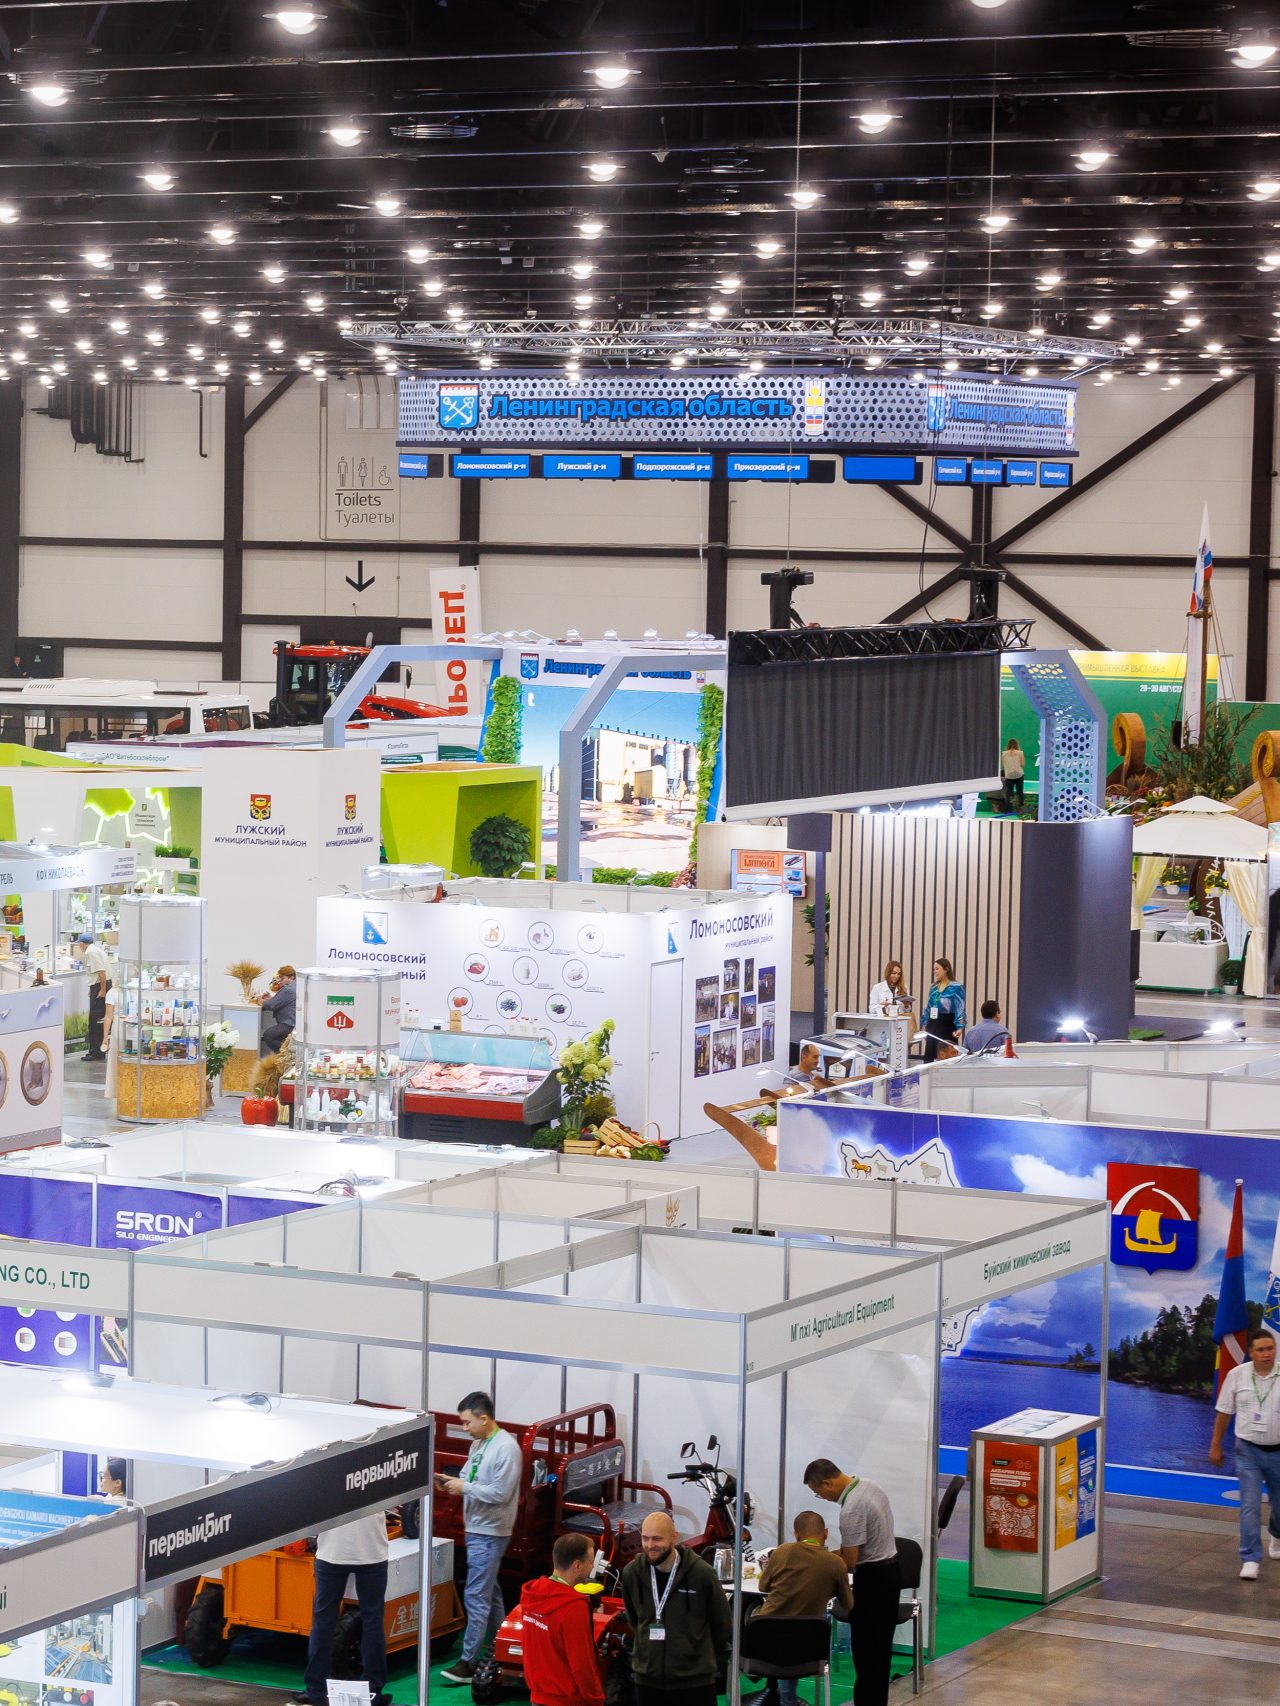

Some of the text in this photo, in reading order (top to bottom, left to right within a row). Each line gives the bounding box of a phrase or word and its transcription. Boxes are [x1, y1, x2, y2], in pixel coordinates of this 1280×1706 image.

[488, 393, 795, 423] Ленинградская область
[949, 397, 1064, 428] Ленинградская область
[457, 461, 526, 471] Ломоносовский р-н
[557, 462, 592, 471] Лужский
[636, 462, 710, 472] Подпорожский р-н
[734, 462, 785, 472] Приозерский
[335, 492, 382, 506] Toilets
[336, 509, 395, 527] Туалеты
[235, 825, 285, 836] ЛУЖСКИЙ
[336, 823, 363, 836] ЛУЖСКИЙ
[214, 836, 307, 847] МУНИЦИПАЛЬНЫЙ РАЙОН
[689, 907, 774, 940] Ломоносовский
[328, 948, 426, 965] Ломоносовский
[116, 1210, 194, 1235] SRON
[116, 1231, 135, 1240] SILO
[983, 1240, 1071, 1282] Буйский химический завод
[24, 1266, 56, 1289] CO.,
[61, 1270, 90, 1290] LTD
[812, 1305, 855, 1338] Agricultural
[856, 1293, 895, 1322] Equipment
